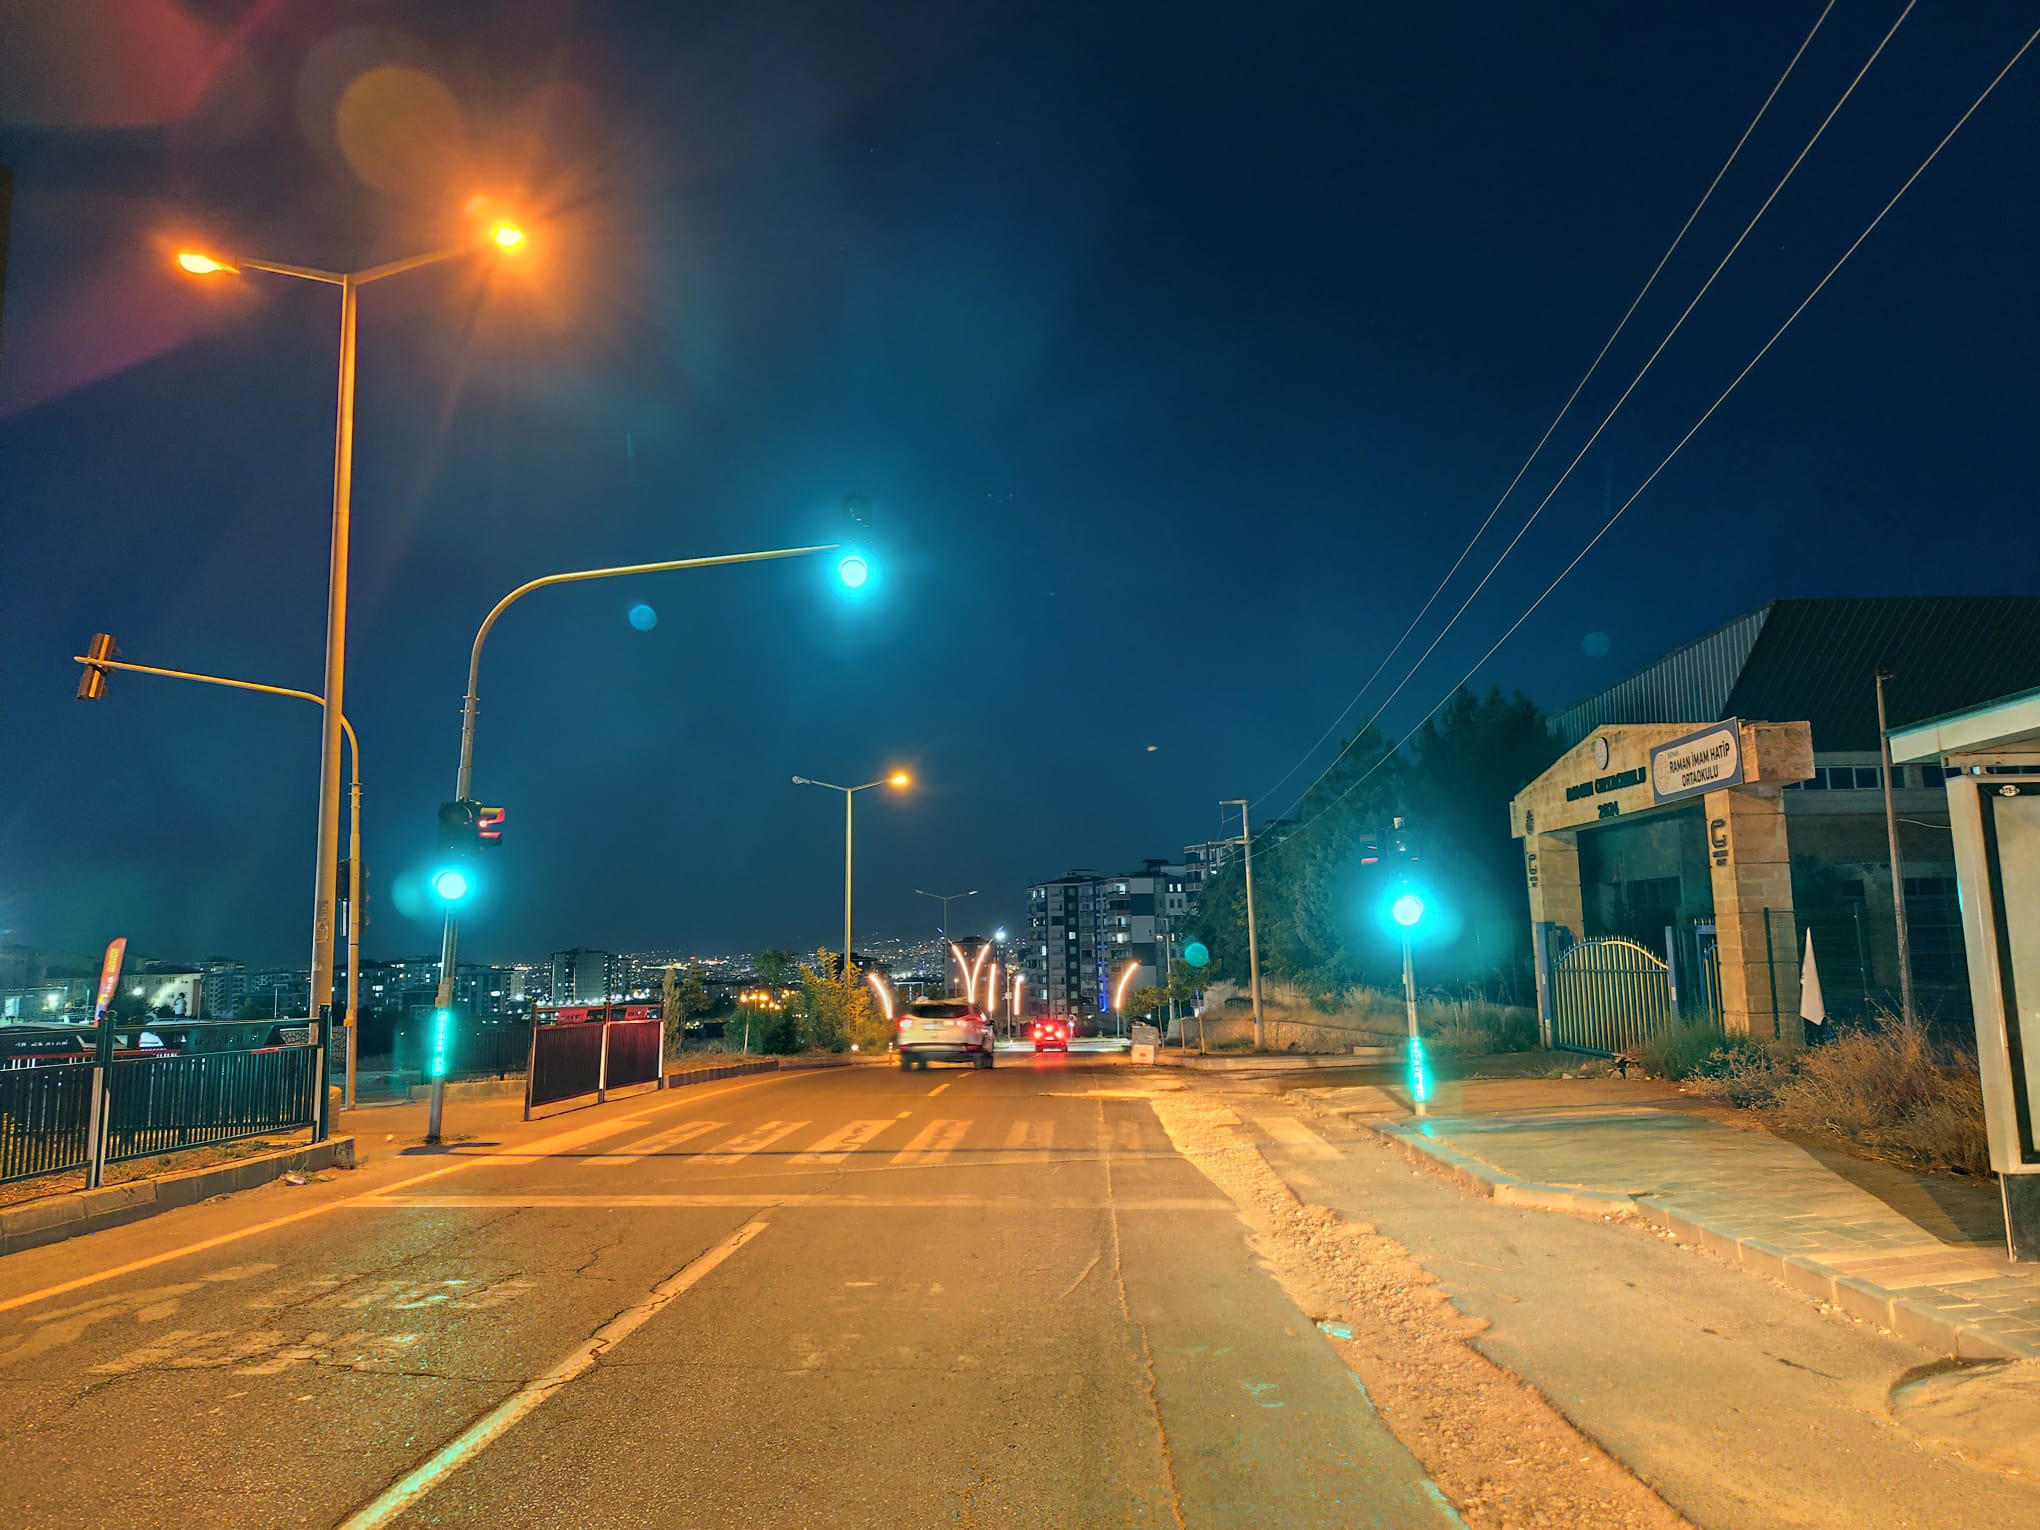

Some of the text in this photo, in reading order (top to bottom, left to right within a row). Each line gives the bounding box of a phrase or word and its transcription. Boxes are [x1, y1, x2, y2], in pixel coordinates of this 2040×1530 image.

[1669, 755, 1691, 774] RAMAN
[1691, 748, 1709, 767] İMAM
[1710, 740, 1730, 762] HATİP
[1681, 764, 1719, 787] ORTAOKULU
